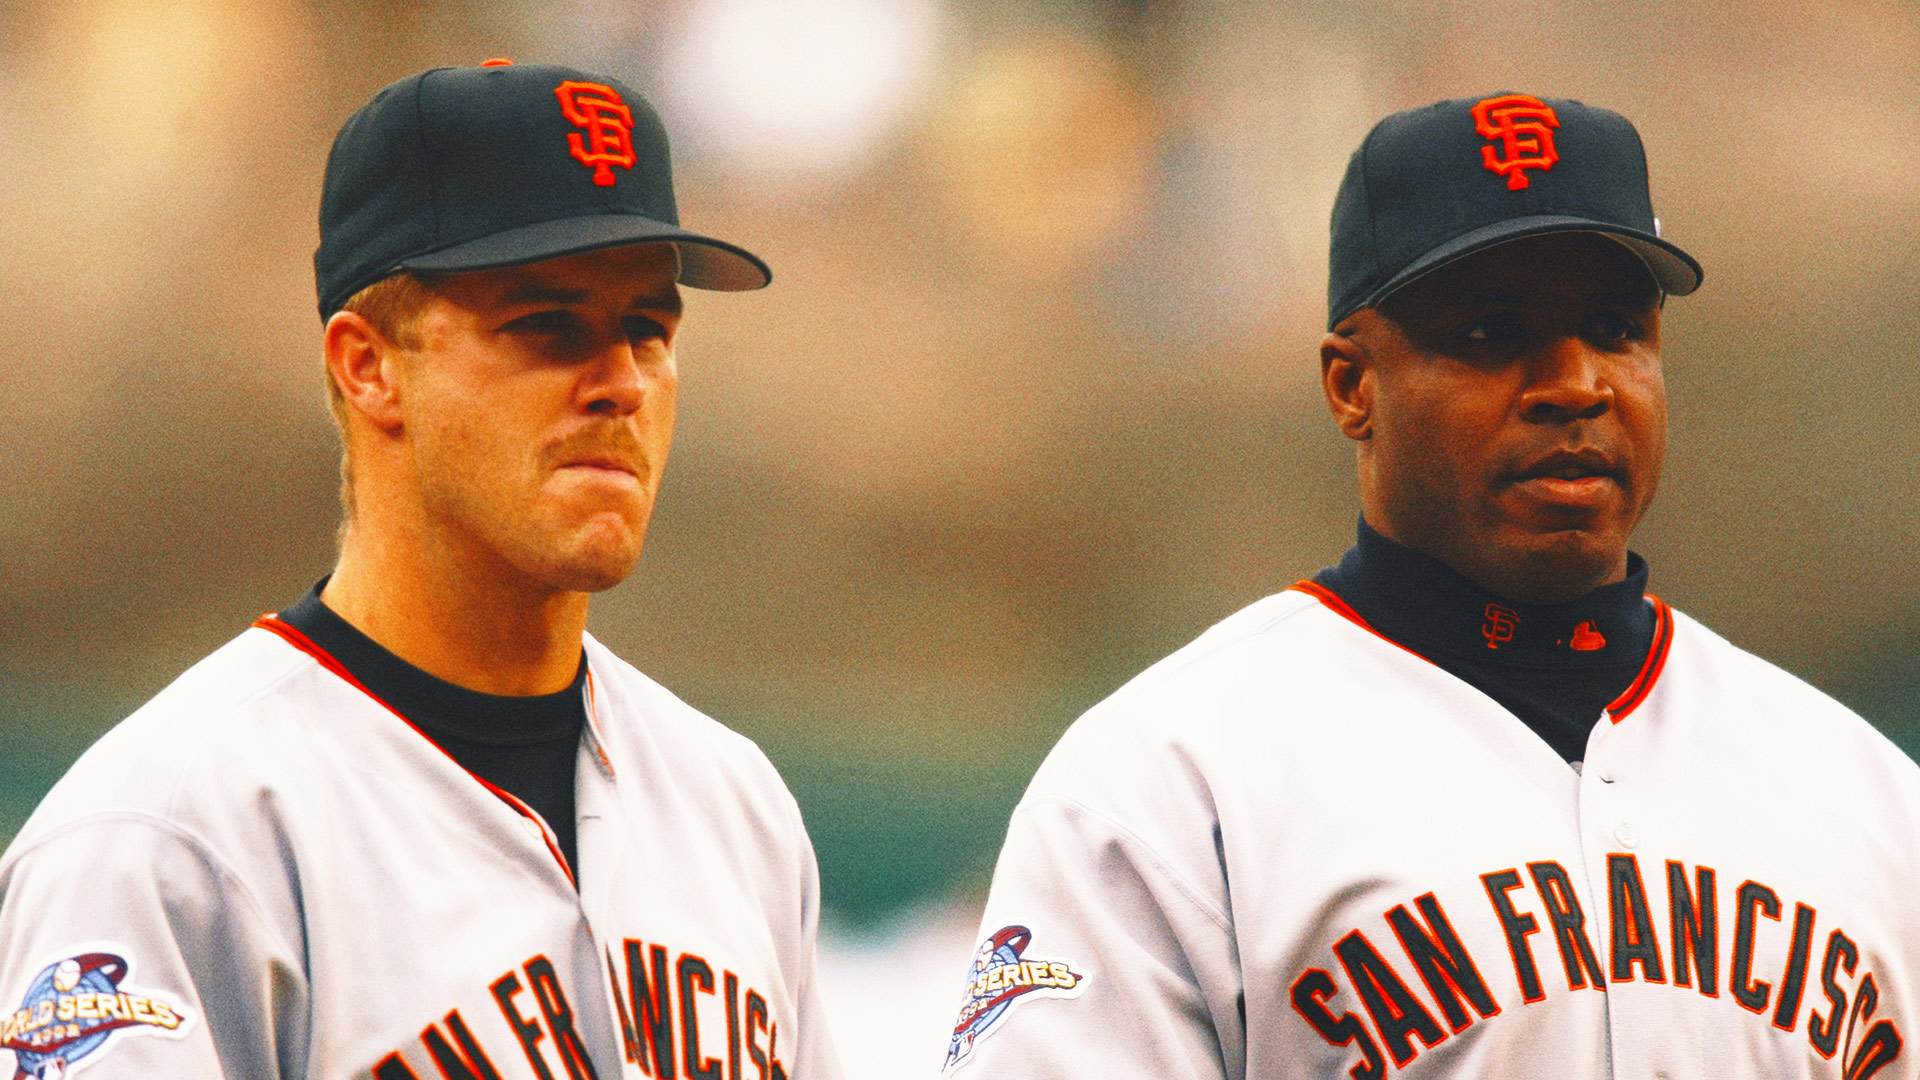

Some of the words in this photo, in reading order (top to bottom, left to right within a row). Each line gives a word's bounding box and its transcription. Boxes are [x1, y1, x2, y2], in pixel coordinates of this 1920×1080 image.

[554, 80, 637, 187] SF
[1470, 94, 1560, 190] SF
[56, 993, 182, 1029] SERIES
[973, 961, 1077, 997] SERIES
[1290, 892, 1502, 1080] SAN
